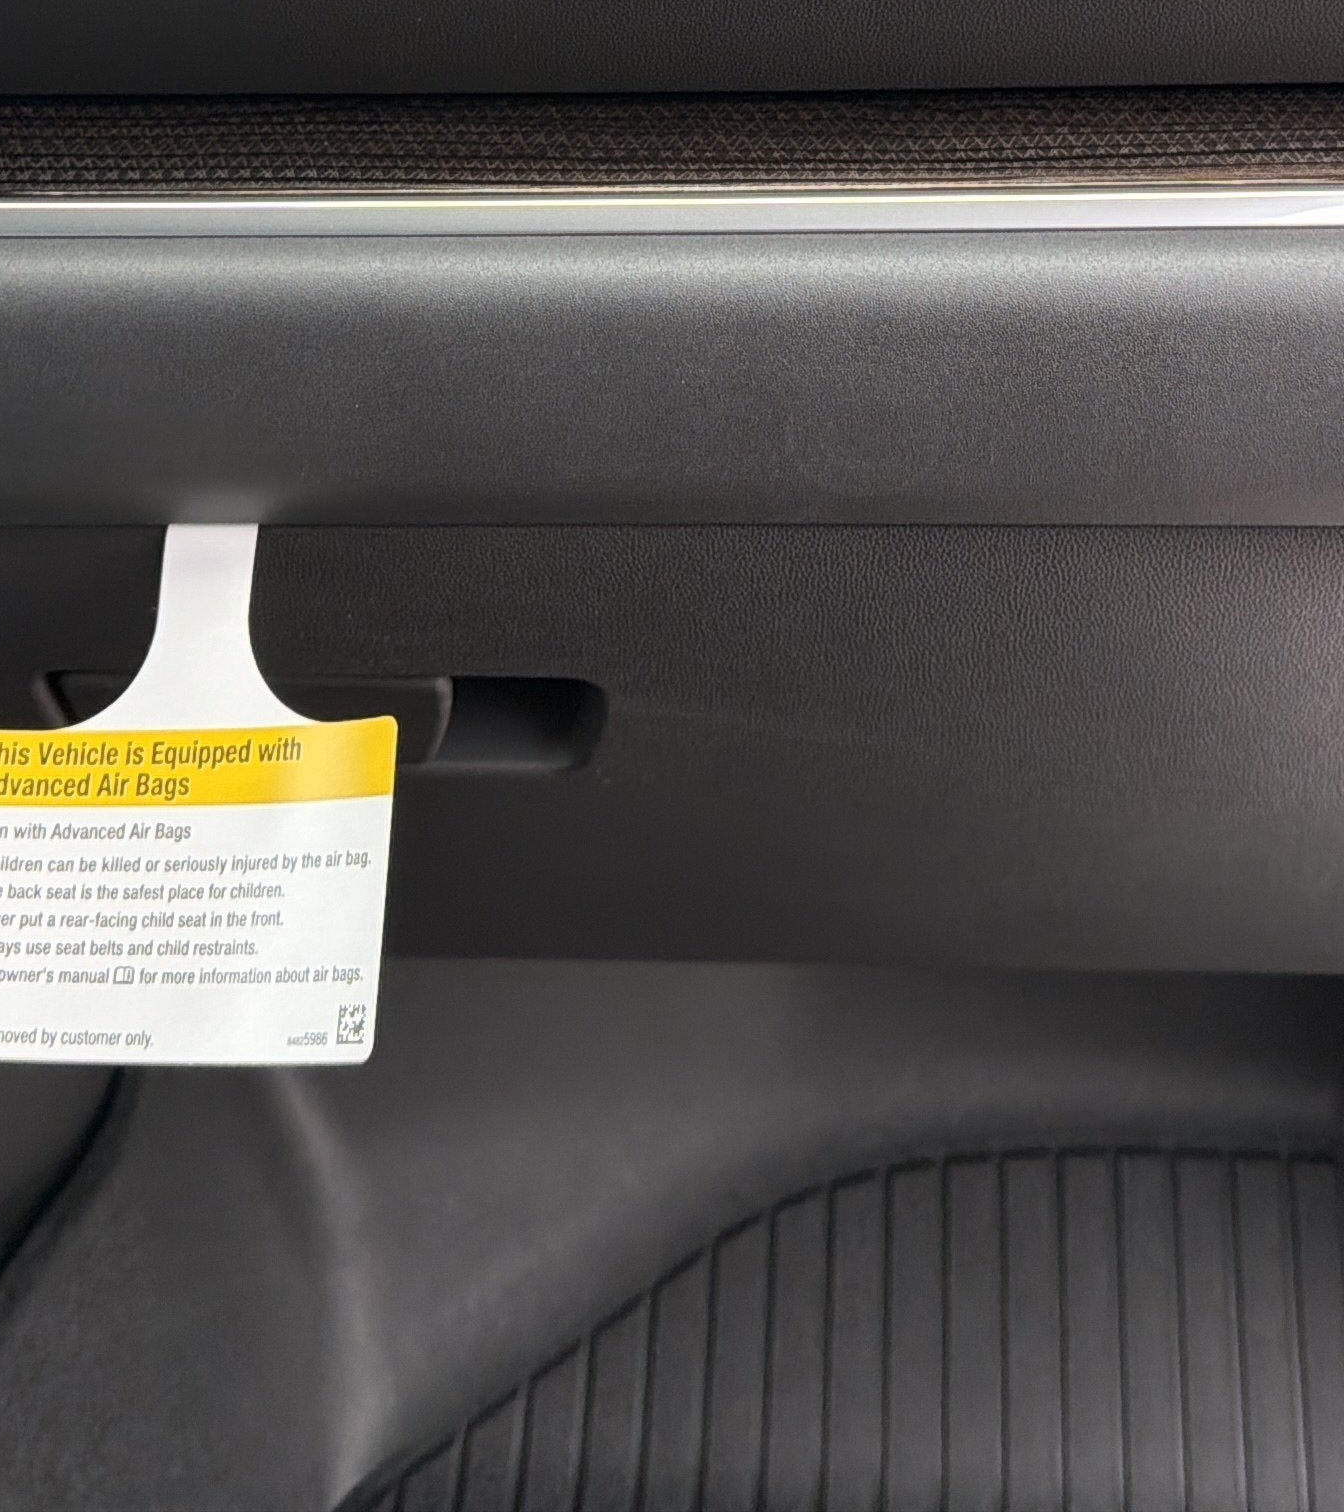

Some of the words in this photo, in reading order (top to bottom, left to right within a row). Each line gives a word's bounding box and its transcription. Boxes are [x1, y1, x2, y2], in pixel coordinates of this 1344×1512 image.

[38, 741, 119, 766] Vehicle
[125, 741, 144, 765] is
[151, 739, 251, 770] Equipped
[258, 736, 302, 762] with
[96, 772, 129, 797] Air
[135, 772, 190, 801] Bags
[14, 823, 46, 839] with
[50, 823, 126, 840] Advanced
[129, 822, 151, 840] Air
[155, 823, 191, 843] Bags
[47, 860, 74, 873] can
[79, 857, 97, 872] be
[101, 856, 141, 872] killed
[145, 860, 161, 873] or
[164, 856, 227, 876] seriously
[231, 854, 278, 875] injured
[282, 853, 298, 873] by
[302, 852, 321, 869] the
[325, 850, 343, 868] air
[345, 850, 371, 869] bag.
[7, 883, 42, 899] back
[46, 884, 76, 900] seat
[80, 884, 92, 900] is
[97, 884, 118, 900] the
[123, 884, 164, 901] safest
[167, 884, 204, 904] place
[208, 883, 227, 900] for
[230, 882, 285, 899] children.
[19, 912, 43, 931] put
[47, 915, 55, 928] a
[59, 911, 137, 932] rear-facing
[141, 911, 174, 929] child
[178, 912, 206, 928] seat
[210, 911, 222, 928] in
[227, 911, 247, 928] the
[251, 910, 283, 927] front.
[25, 942, 51, 955] use
[55, 940, 86, 956] seat
[89, 940, 123, 957] belts
[127, 939, 154, 956] and
[157, 939, 190, 957] child
[193, 939, 258, 956] restraints.
[58, 968, 110, 984] manual
[139, 968, 158, 985] for
[161, 971, 195, 985] more
[199, 967, 271, 984] information
[275, 967, 310, 983] about
[313, 965, 329, 983] air
[332, 965, 363, 985] bags.
[41, 1028, 58, 1048] by
[60, 1030, 122, 1046] customer
[125, 1030, 153, 1050] only.
